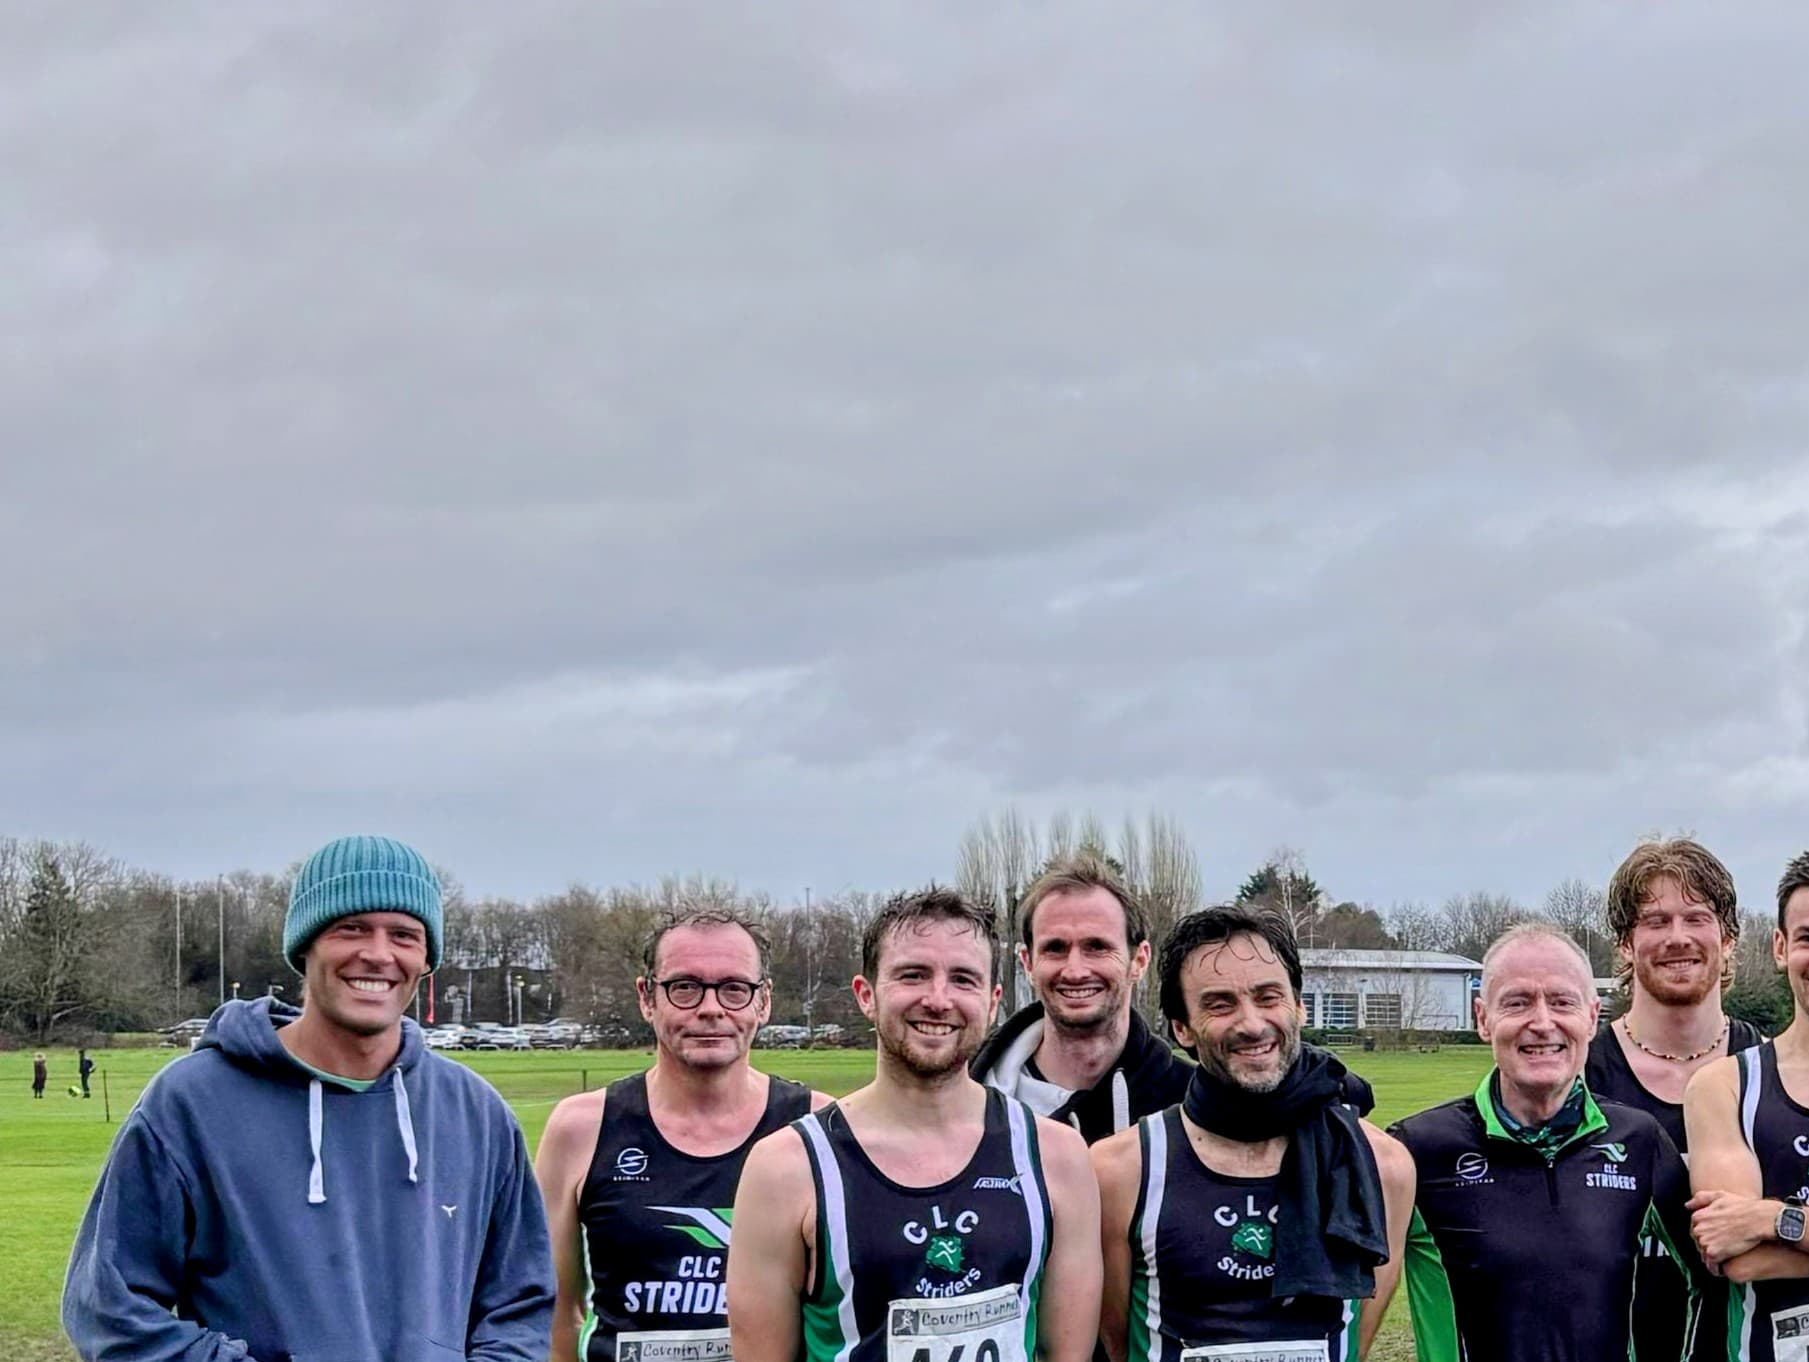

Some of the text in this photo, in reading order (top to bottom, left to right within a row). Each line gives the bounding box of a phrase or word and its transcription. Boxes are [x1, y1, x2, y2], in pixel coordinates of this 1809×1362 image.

[1604, 1163, 1618, 1174] CLC
[1586, 1173, 1636, 1191] STRIDERS
[903, 1205, 979, 1244] CLC
[678, 1256, 722, 1278] CLC
[1217, 1255, 1276, 1281] Stride
[915, 1267, 982, 1298] Striders
[623, 1281, 728, 1315] STRIDE
[921, 1308, 980, 1327] Coventry
[643, 1341, 732, 1360] Coventry Run
